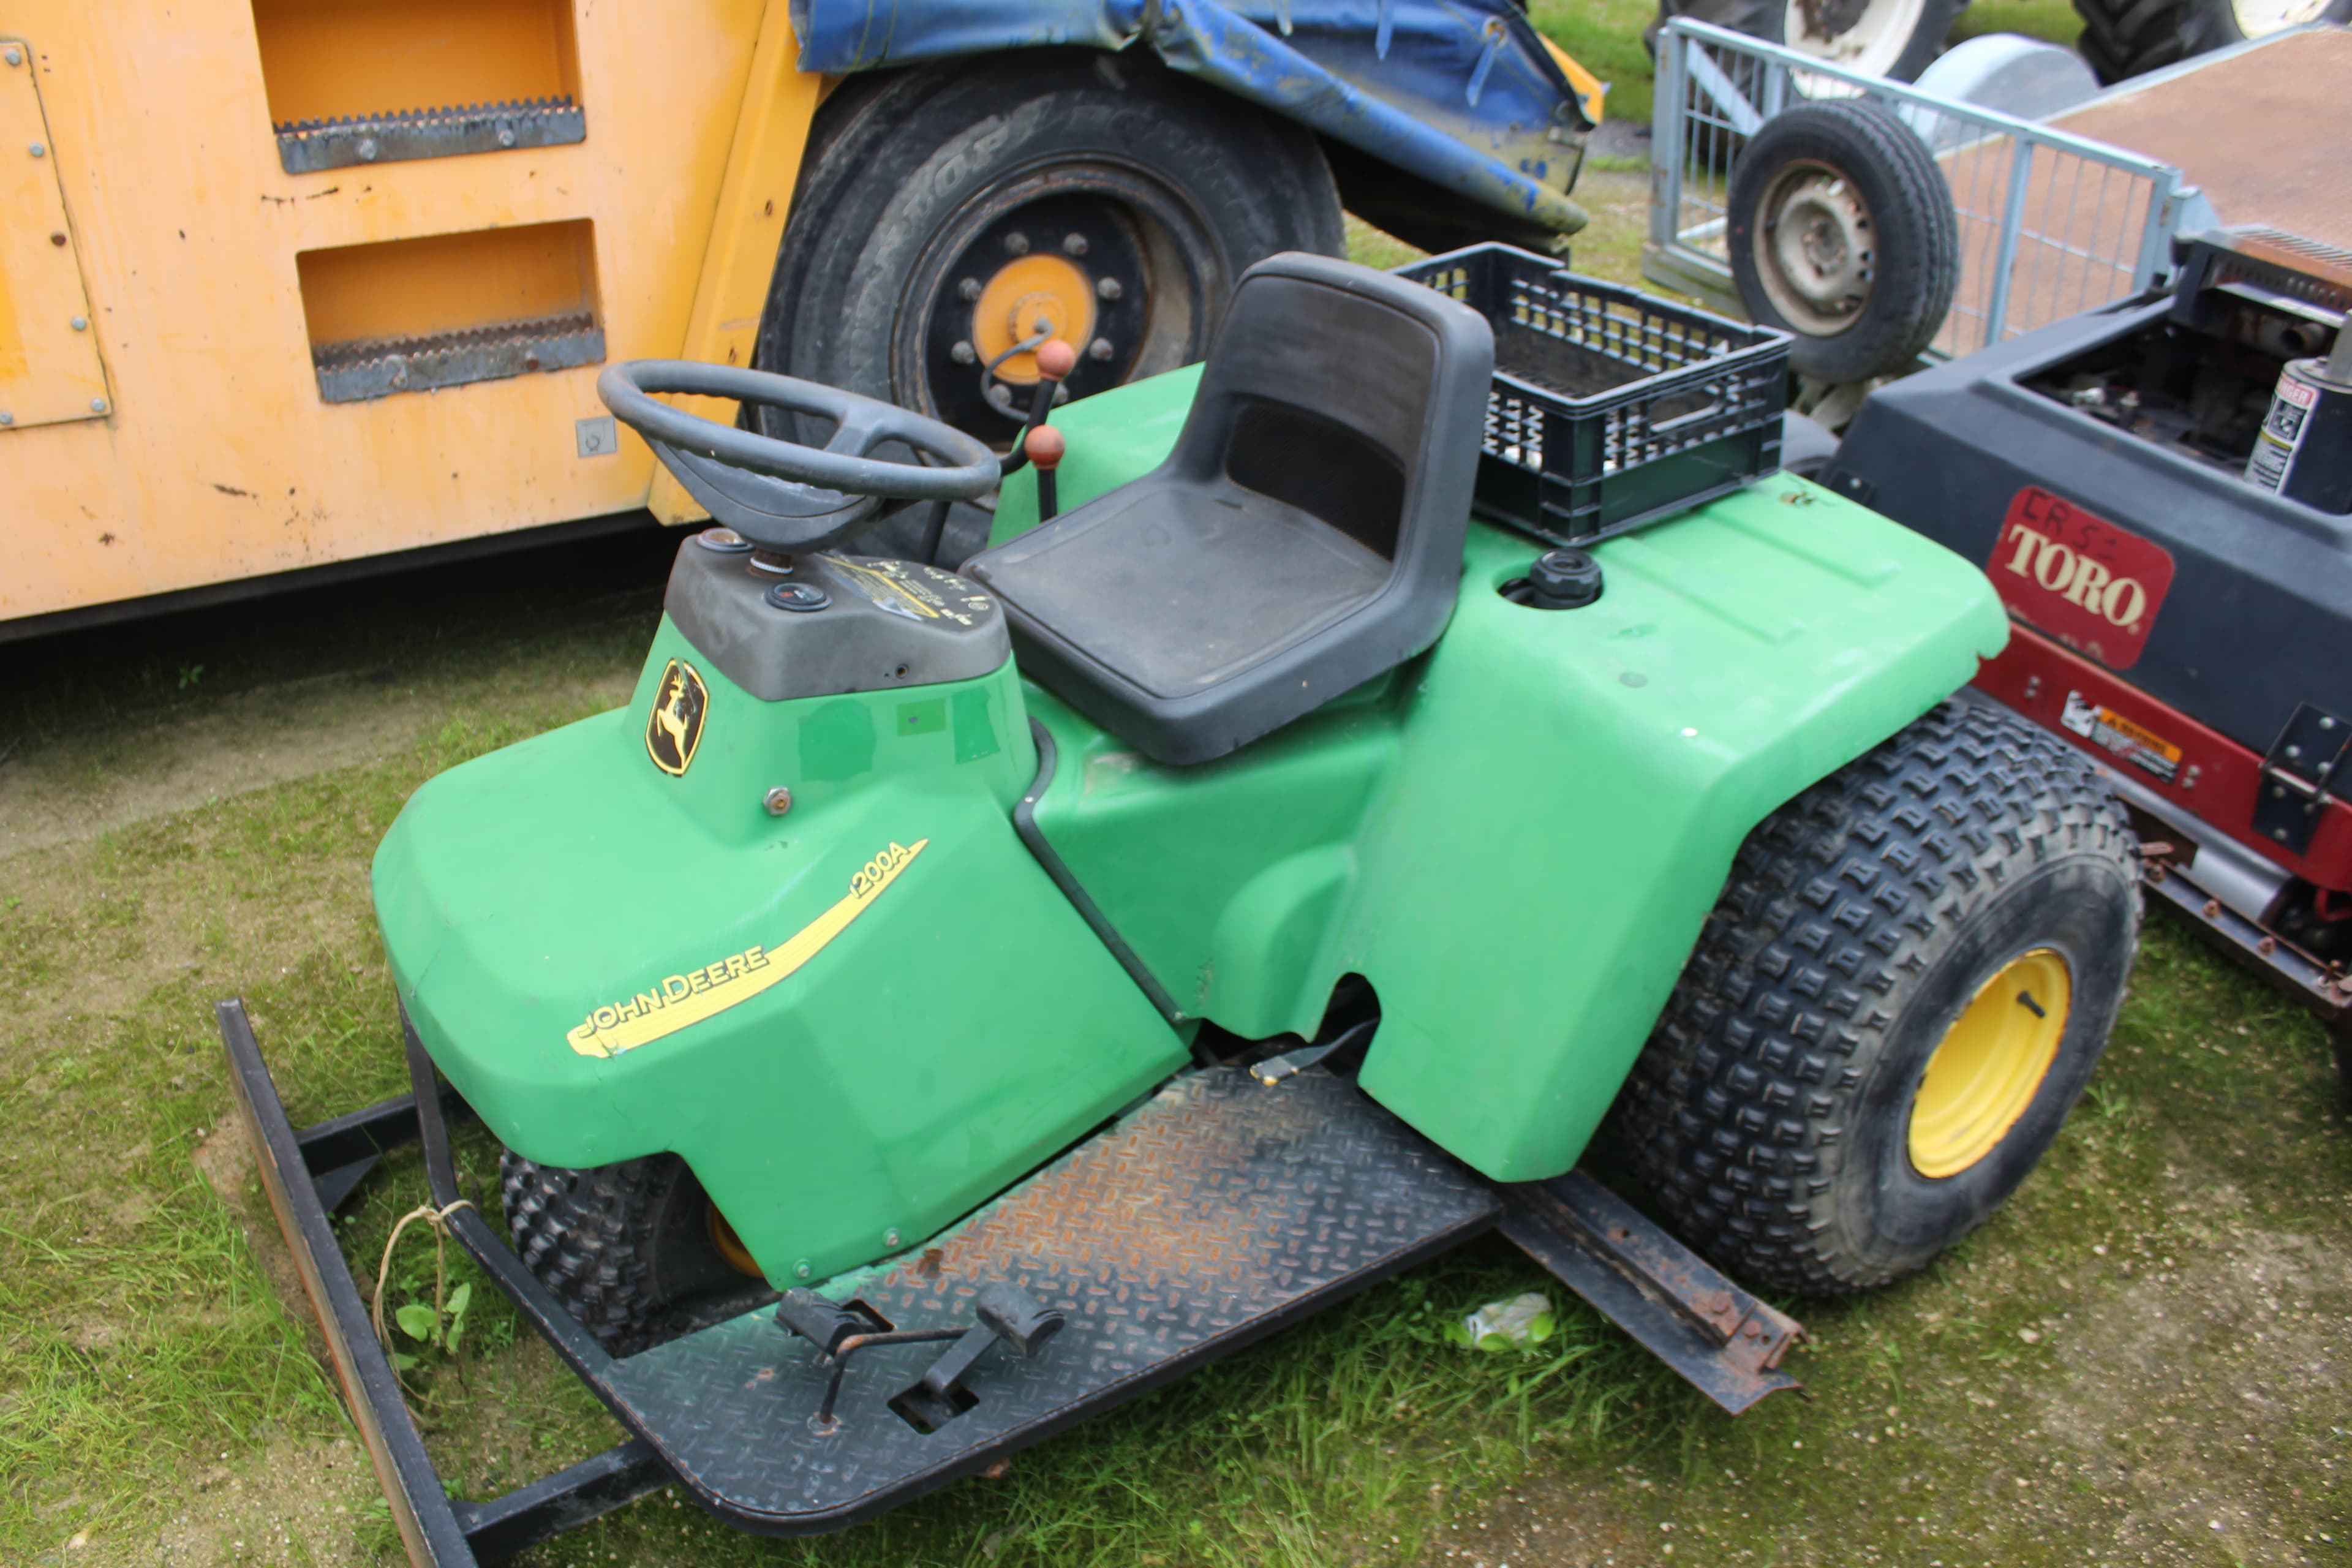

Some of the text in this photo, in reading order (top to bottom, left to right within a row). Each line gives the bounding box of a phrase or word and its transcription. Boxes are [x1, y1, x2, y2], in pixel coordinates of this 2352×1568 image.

[2005, 524, 2147, 627] TORO
[849, 841, 911, 899] 1200A
[577, 945, 770, 1039] JOHN DEERE
